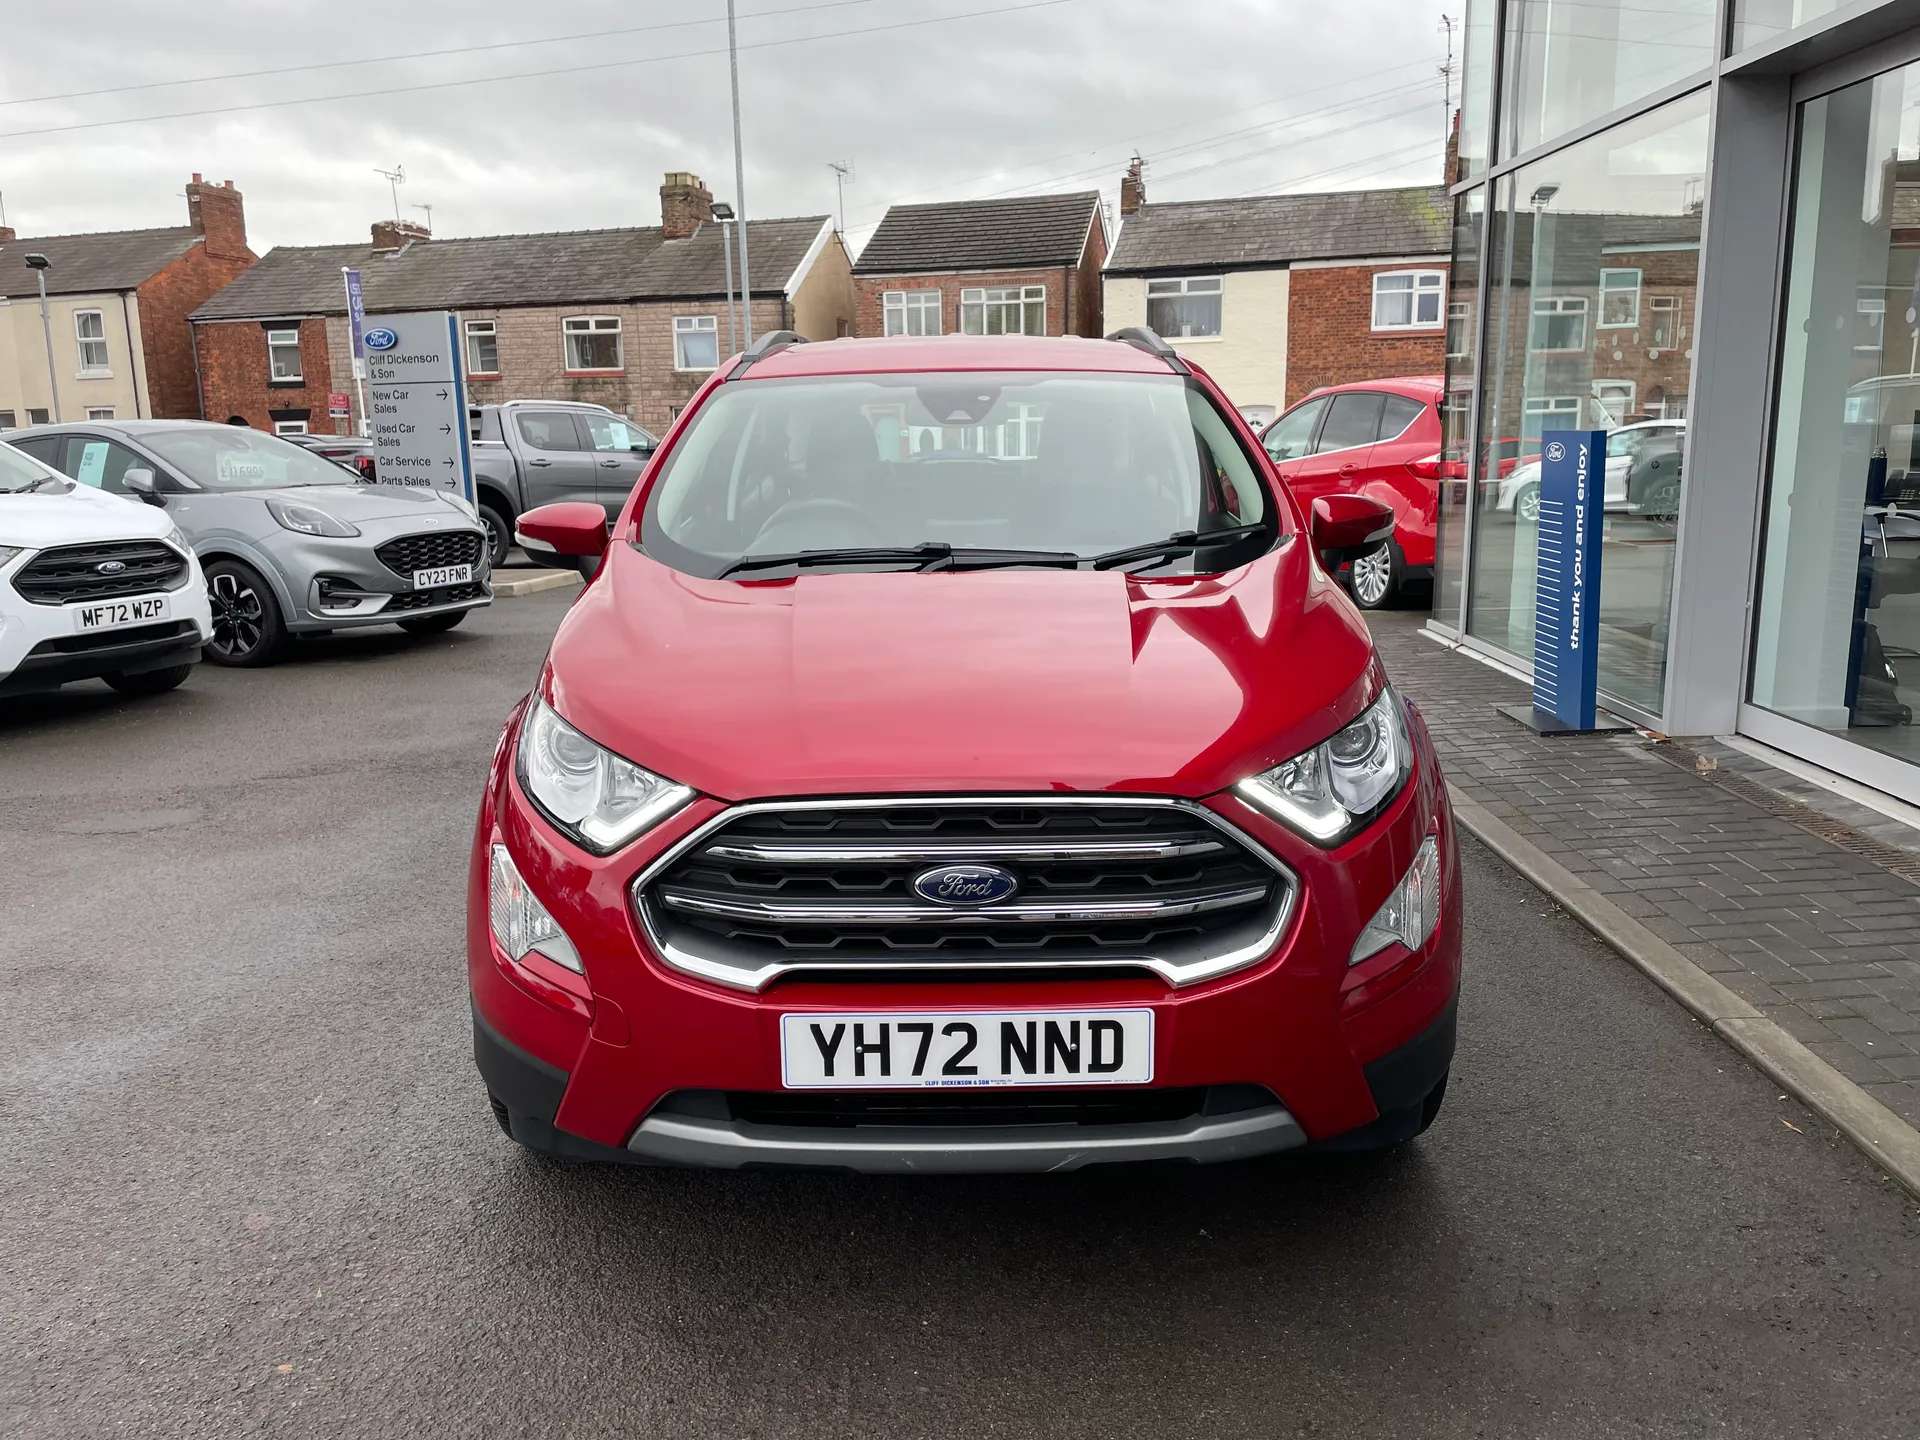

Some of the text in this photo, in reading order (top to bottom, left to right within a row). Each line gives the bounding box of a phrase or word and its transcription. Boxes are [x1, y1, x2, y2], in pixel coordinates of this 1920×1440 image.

[370, 331, 389, 346] Ford
[369, 354, 439, 366] Cliff Dickenson
[370, 368, 395, 379] & Son
[372, 389, 409, 401] New Car
[374, 403, 398, 414] Sales
[376, 423, 416, 434] Used Car
[377, 437, 401, 447] Sales
[1548, 443, 1563, 459] Ford
[379, 456, 431, 467] Car Service
[381, 475, 431, 486] Parts Sales
[1570, 443, 1588, 650] thank you and enjoy
[419, 567, 468, 586] CY23 FNR
[82, 600, 163, 627] MF72 WZP
[938, 872, 994, 897] Ford
[809, 1019, 1125, 1077] YH72 NND
